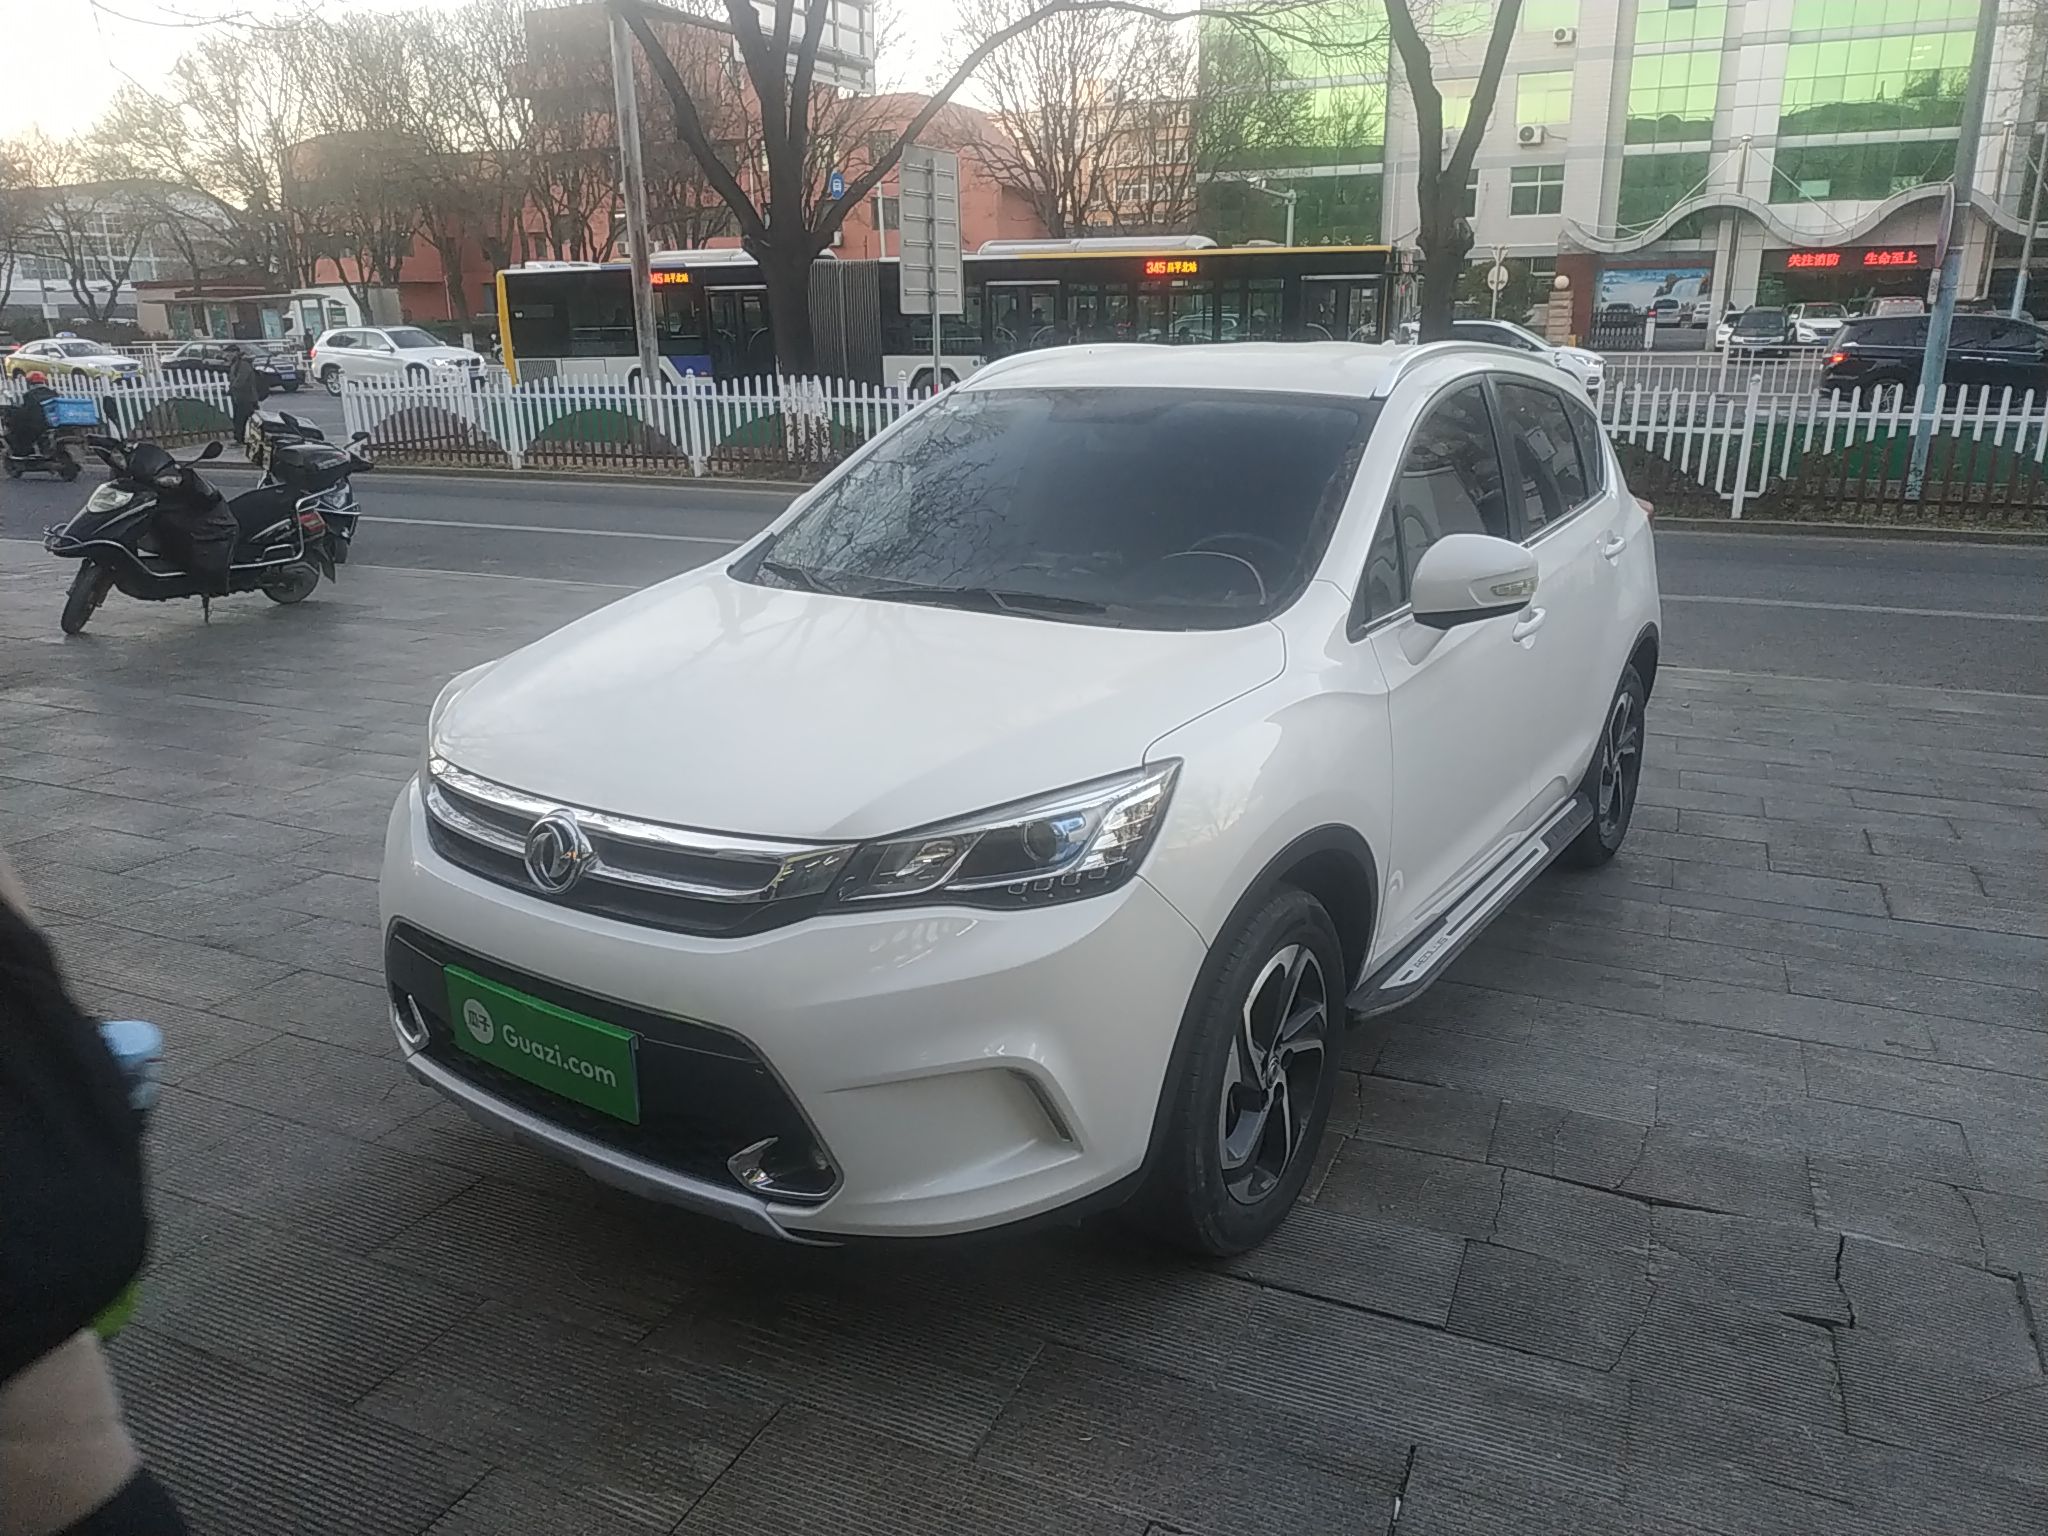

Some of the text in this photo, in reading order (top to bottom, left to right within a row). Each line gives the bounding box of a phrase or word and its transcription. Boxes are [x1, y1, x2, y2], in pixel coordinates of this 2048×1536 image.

[1788, 251, 1917, 267] 关注消防 生命至上
[502, 1024, 616, 1087] Guazi.com
